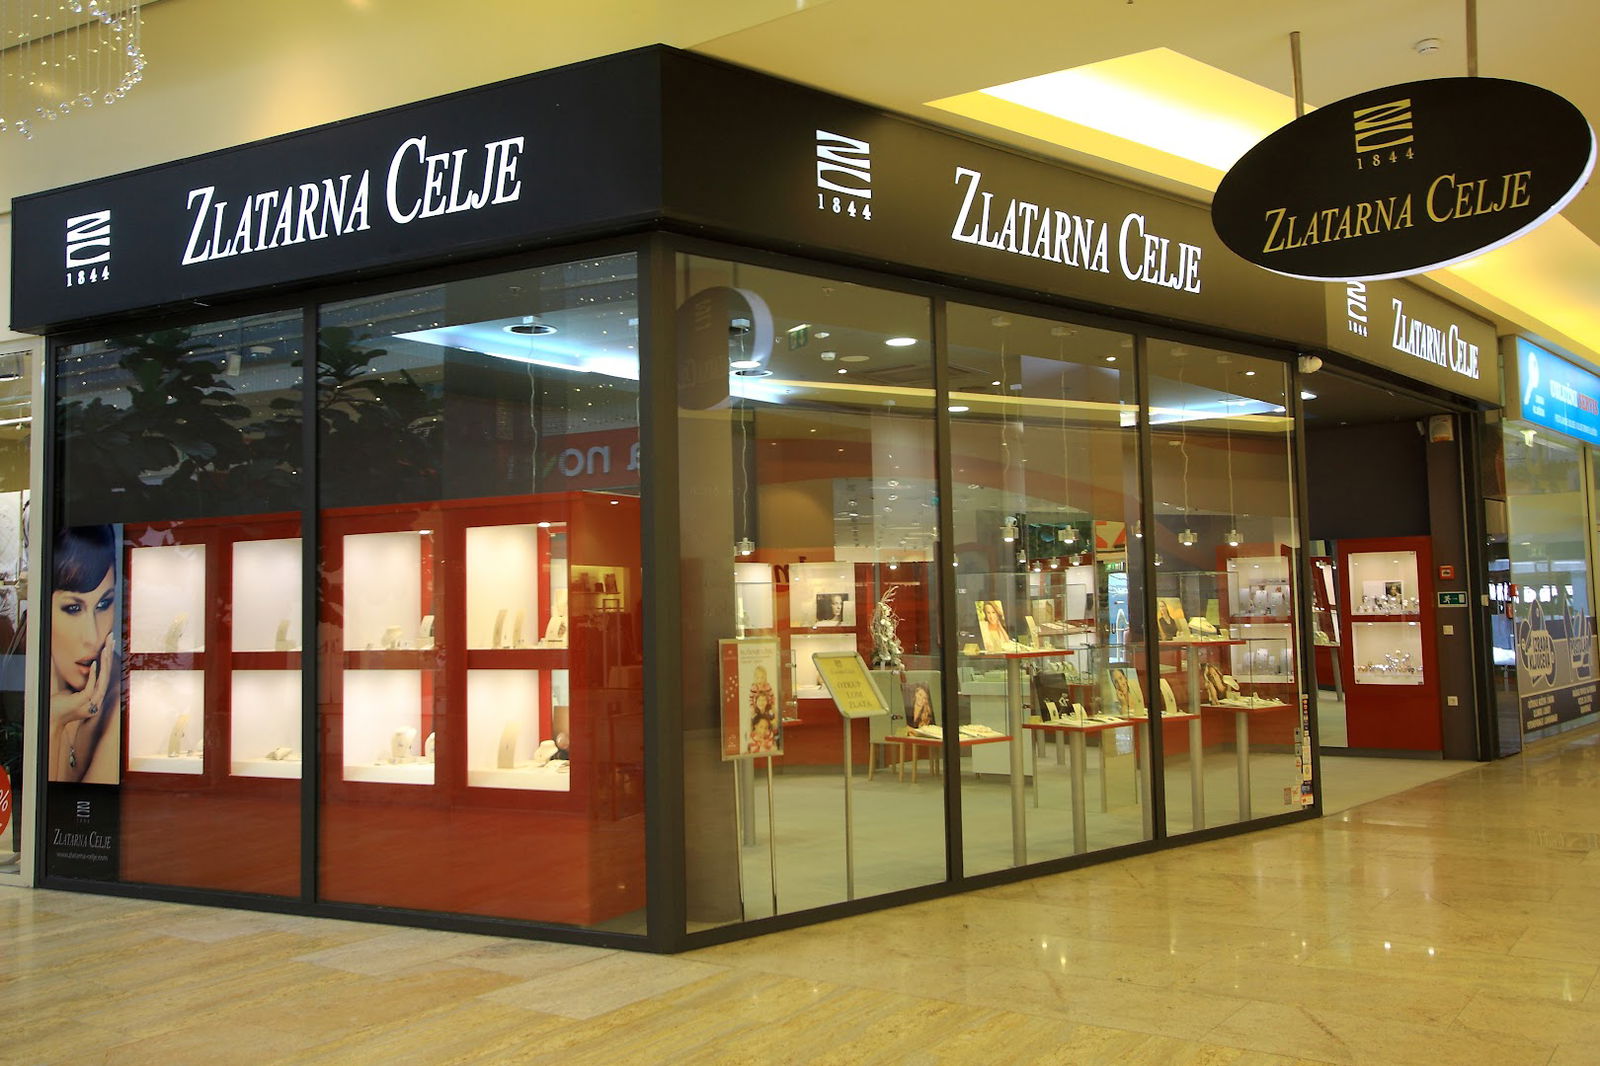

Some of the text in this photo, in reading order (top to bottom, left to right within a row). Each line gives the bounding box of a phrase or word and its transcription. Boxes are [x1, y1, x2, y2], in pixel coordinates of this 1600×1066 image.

[1357, 147, 1415, 170] 1844
[181, 135, 525, 267] ZLATARNA CELJE
[817, 193, 872, 220] 1844
[1263, 171, 1532, 253] ZLATARNA CELJE
[951, 166, 1202, 294] ZLATARNA CELJE
[66, 266, 110, 287] 1844
[1392, 298, 1480, 380] ZLATARNA CELJE
[53, 828, 112, 849] ZLATARNA CELJE
